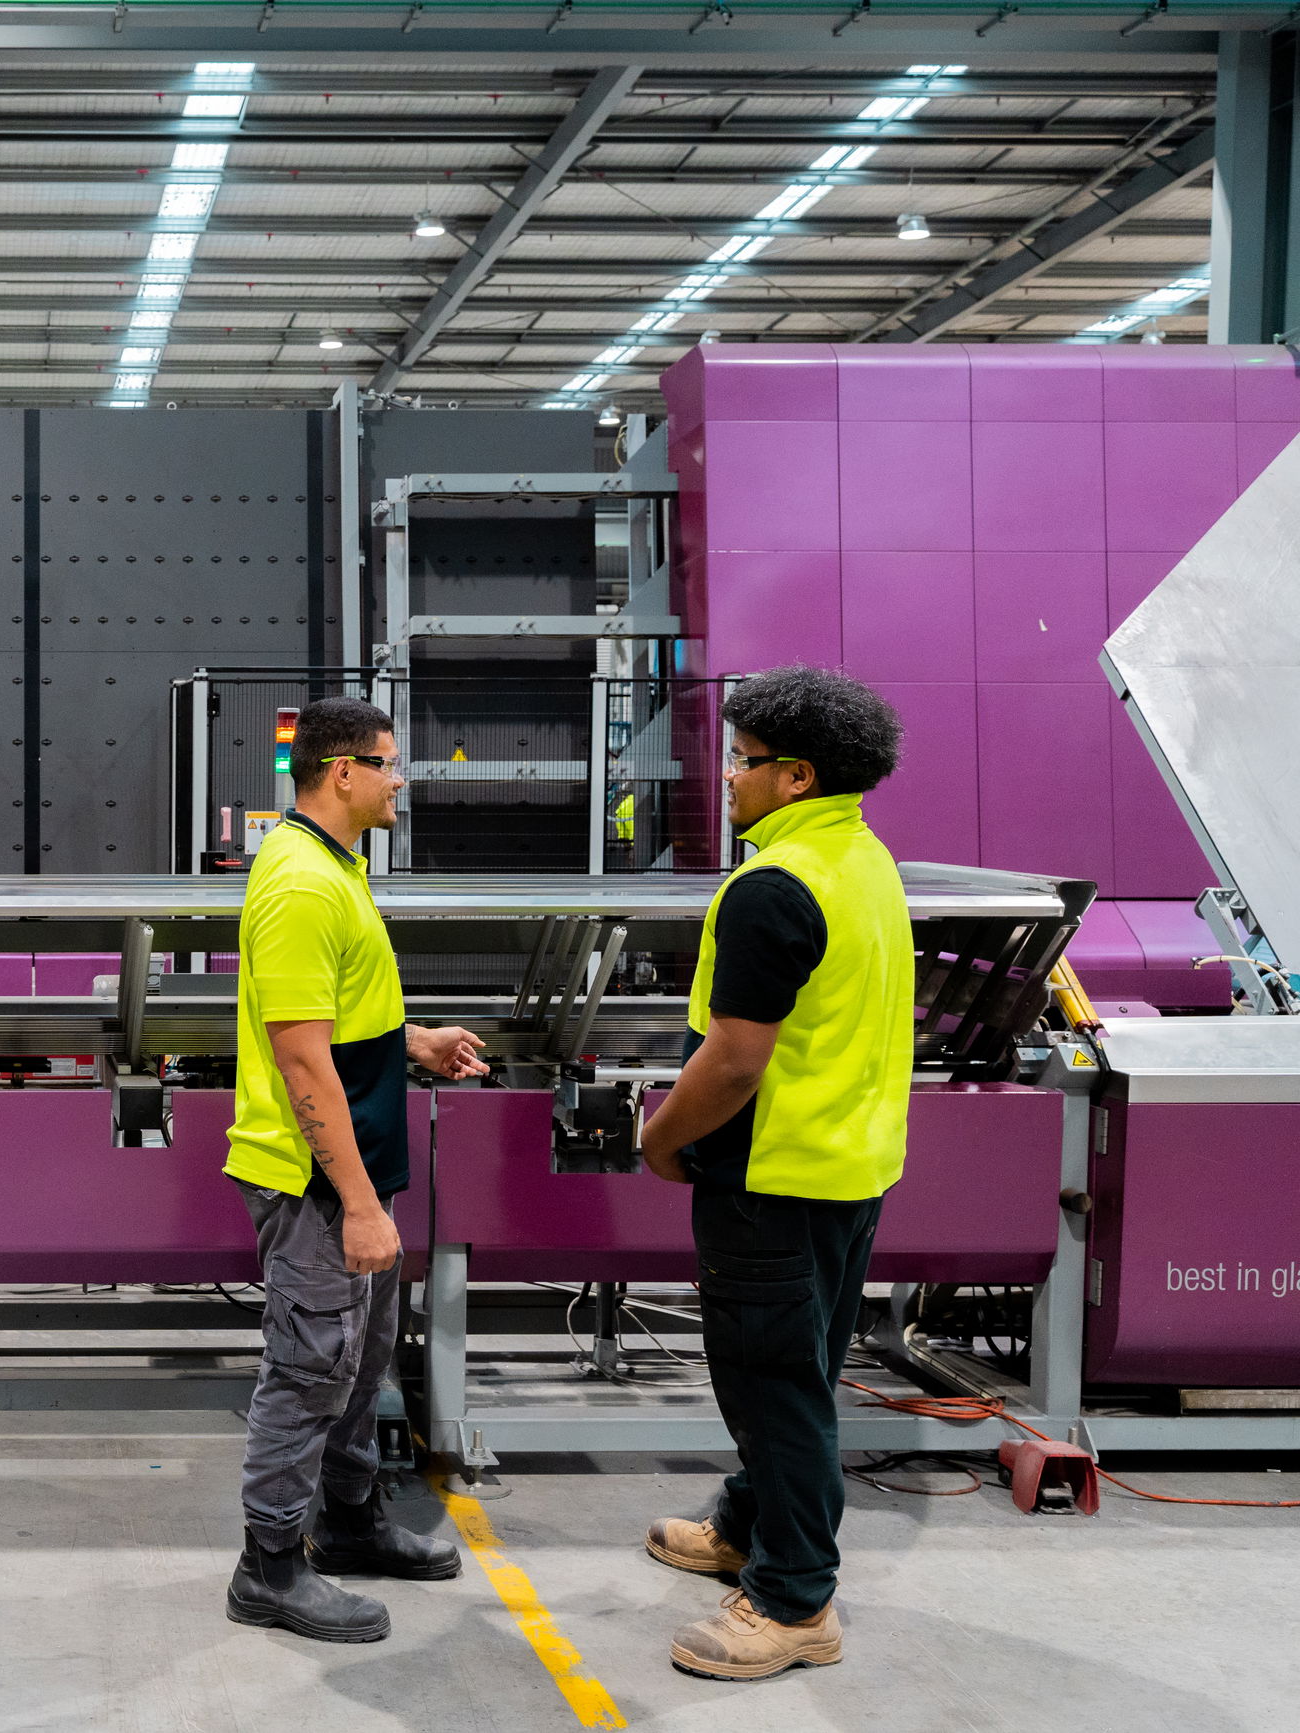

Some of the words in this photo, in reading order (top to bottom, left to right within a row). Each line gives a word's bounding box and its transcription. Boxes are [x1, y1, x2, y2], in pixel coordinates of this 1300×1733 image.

[1167, 1261, 1227, 1291] best
[1237, 1261, 1260, 1291] in
[1271, 1261, 1300, 1298] gl
